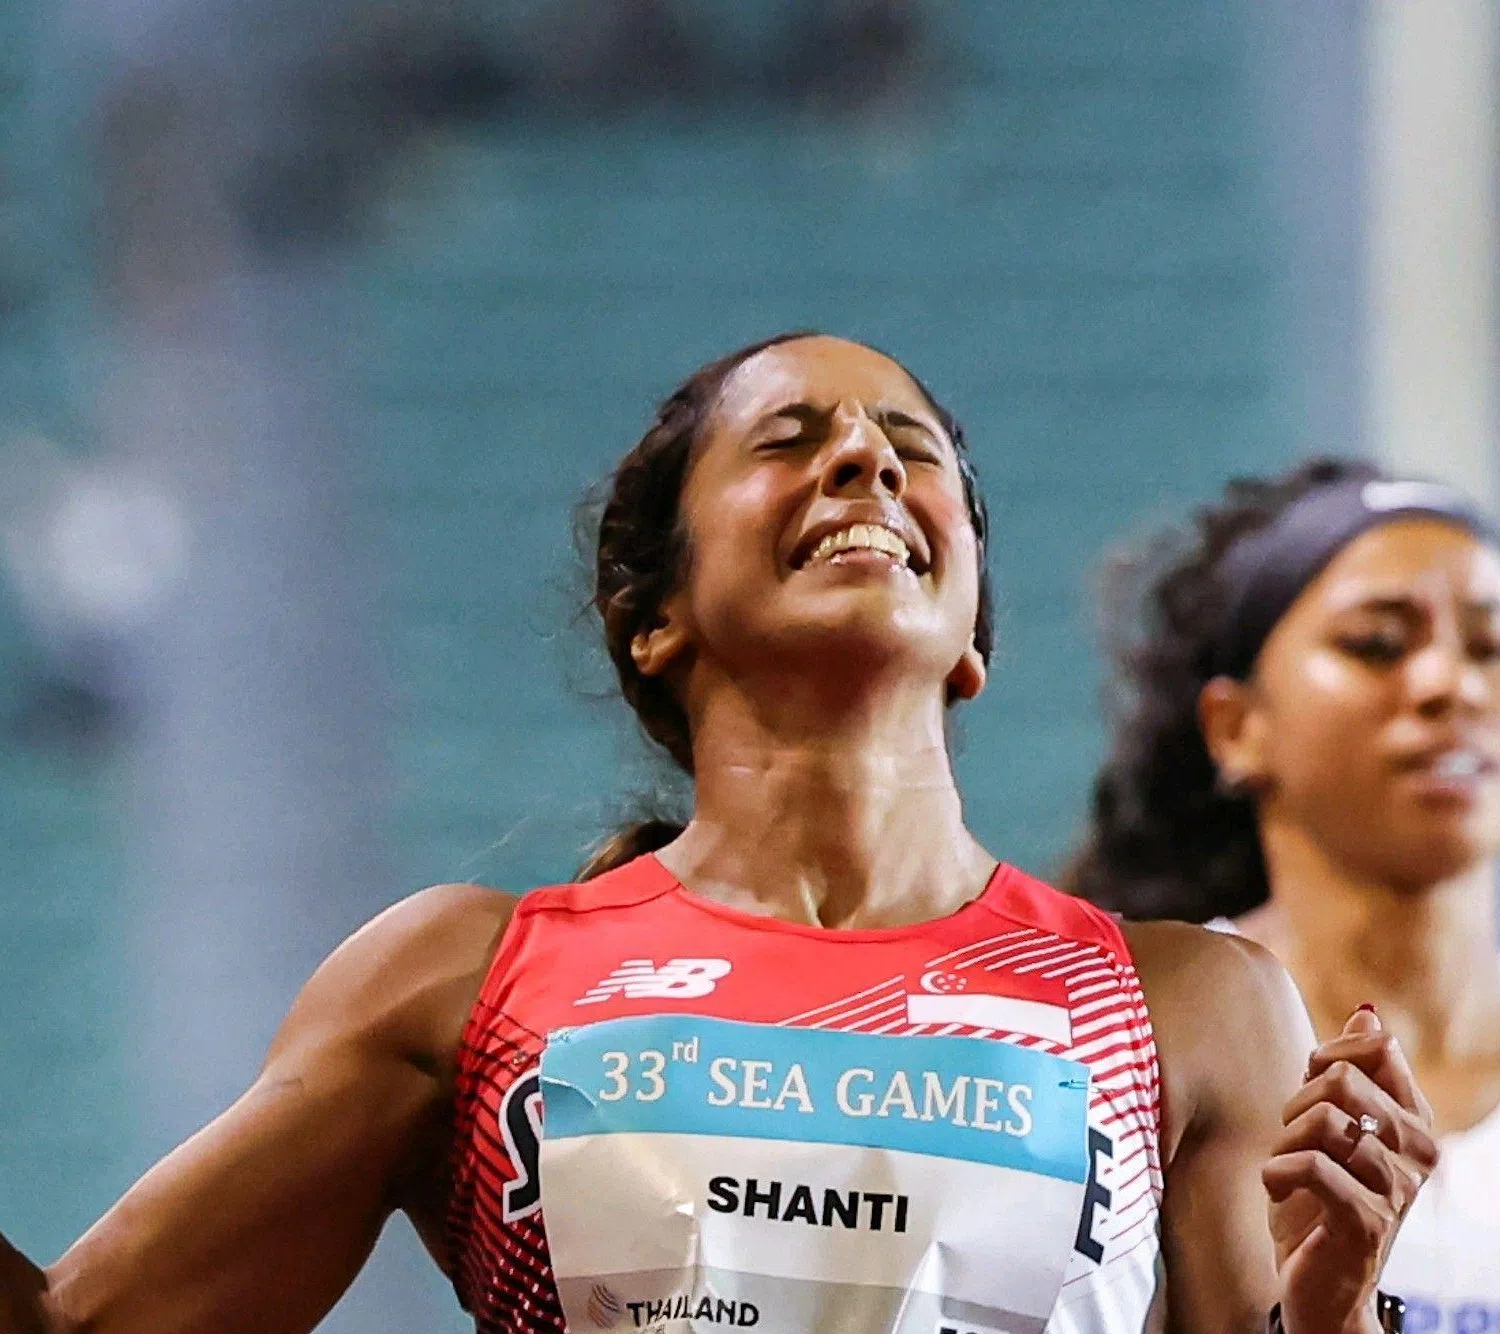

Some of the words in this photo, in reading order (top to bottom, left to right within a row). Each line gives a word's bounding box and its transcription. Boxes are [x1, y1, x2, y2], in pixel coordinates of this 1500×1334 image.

[574, 957, 733, 1008] NB
[600, 1036, 700, 1103] 33rd
[707, 1057, 815, 1115] SEA
[836, 1069, 1033, 1138] GAMES
[706, 1175, 909, 1233] SHANTI
[626, 1296, 760, 1328] THAILAND
